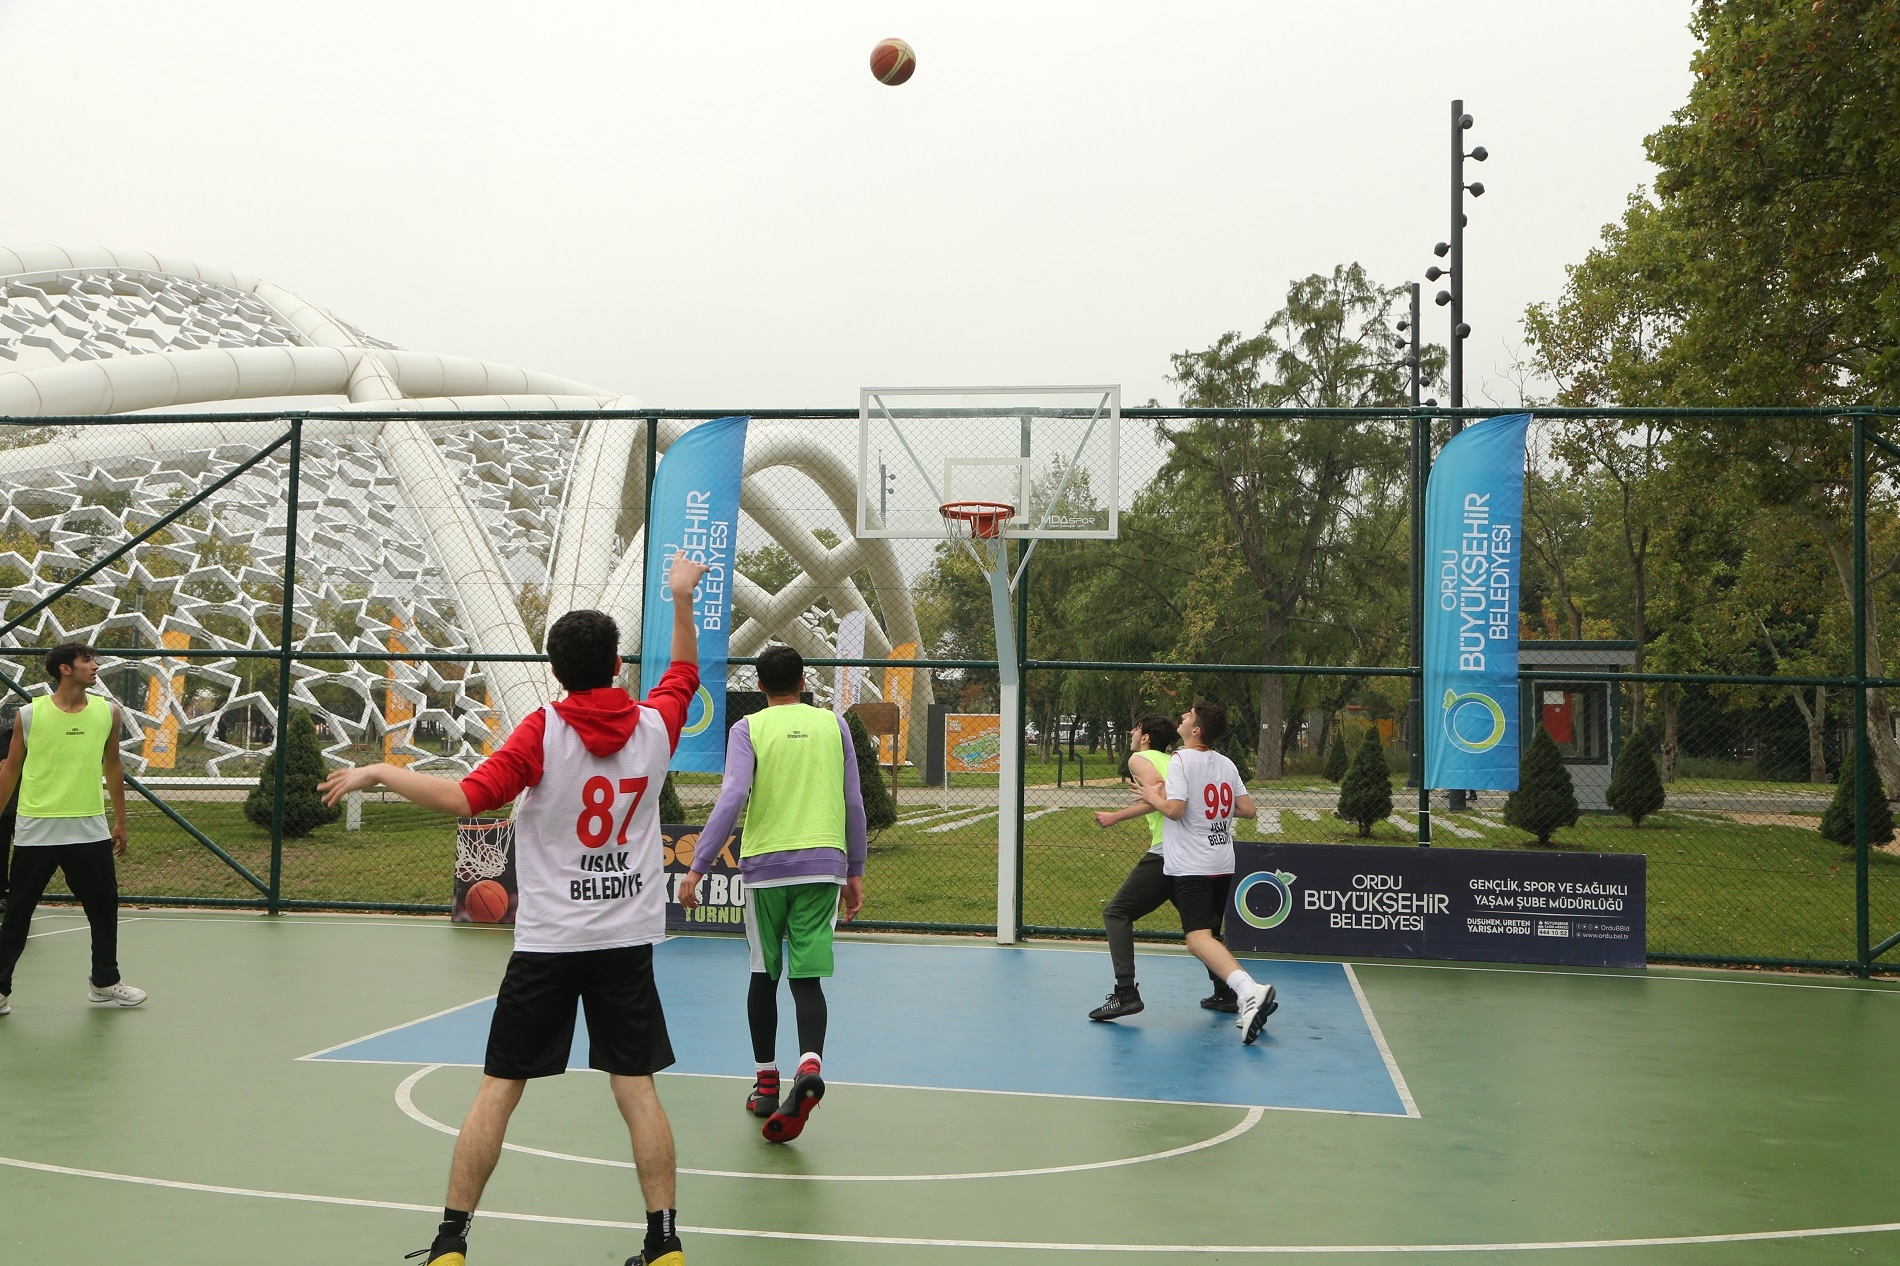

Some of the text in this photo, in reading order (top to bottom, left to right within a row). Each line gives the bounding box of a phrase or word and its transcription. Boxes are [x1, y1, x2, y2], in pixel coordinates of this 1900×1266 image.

[1441, 550, 1459, 611] ORDU
[1203, 782, 1233, 820] 99
[576, 775, 649, 848] 87
[1352, 874, 1402, 890] ORDU
[1469, 878, 1628, 896] GENÇLİK, SPOR VE SAĞLIKLI
[1474, 894, 1623, 911] YAŞAM ŞUBE MÜDÜRLÜĞÜ
[1505, 926, 1531, 934] ORDU
